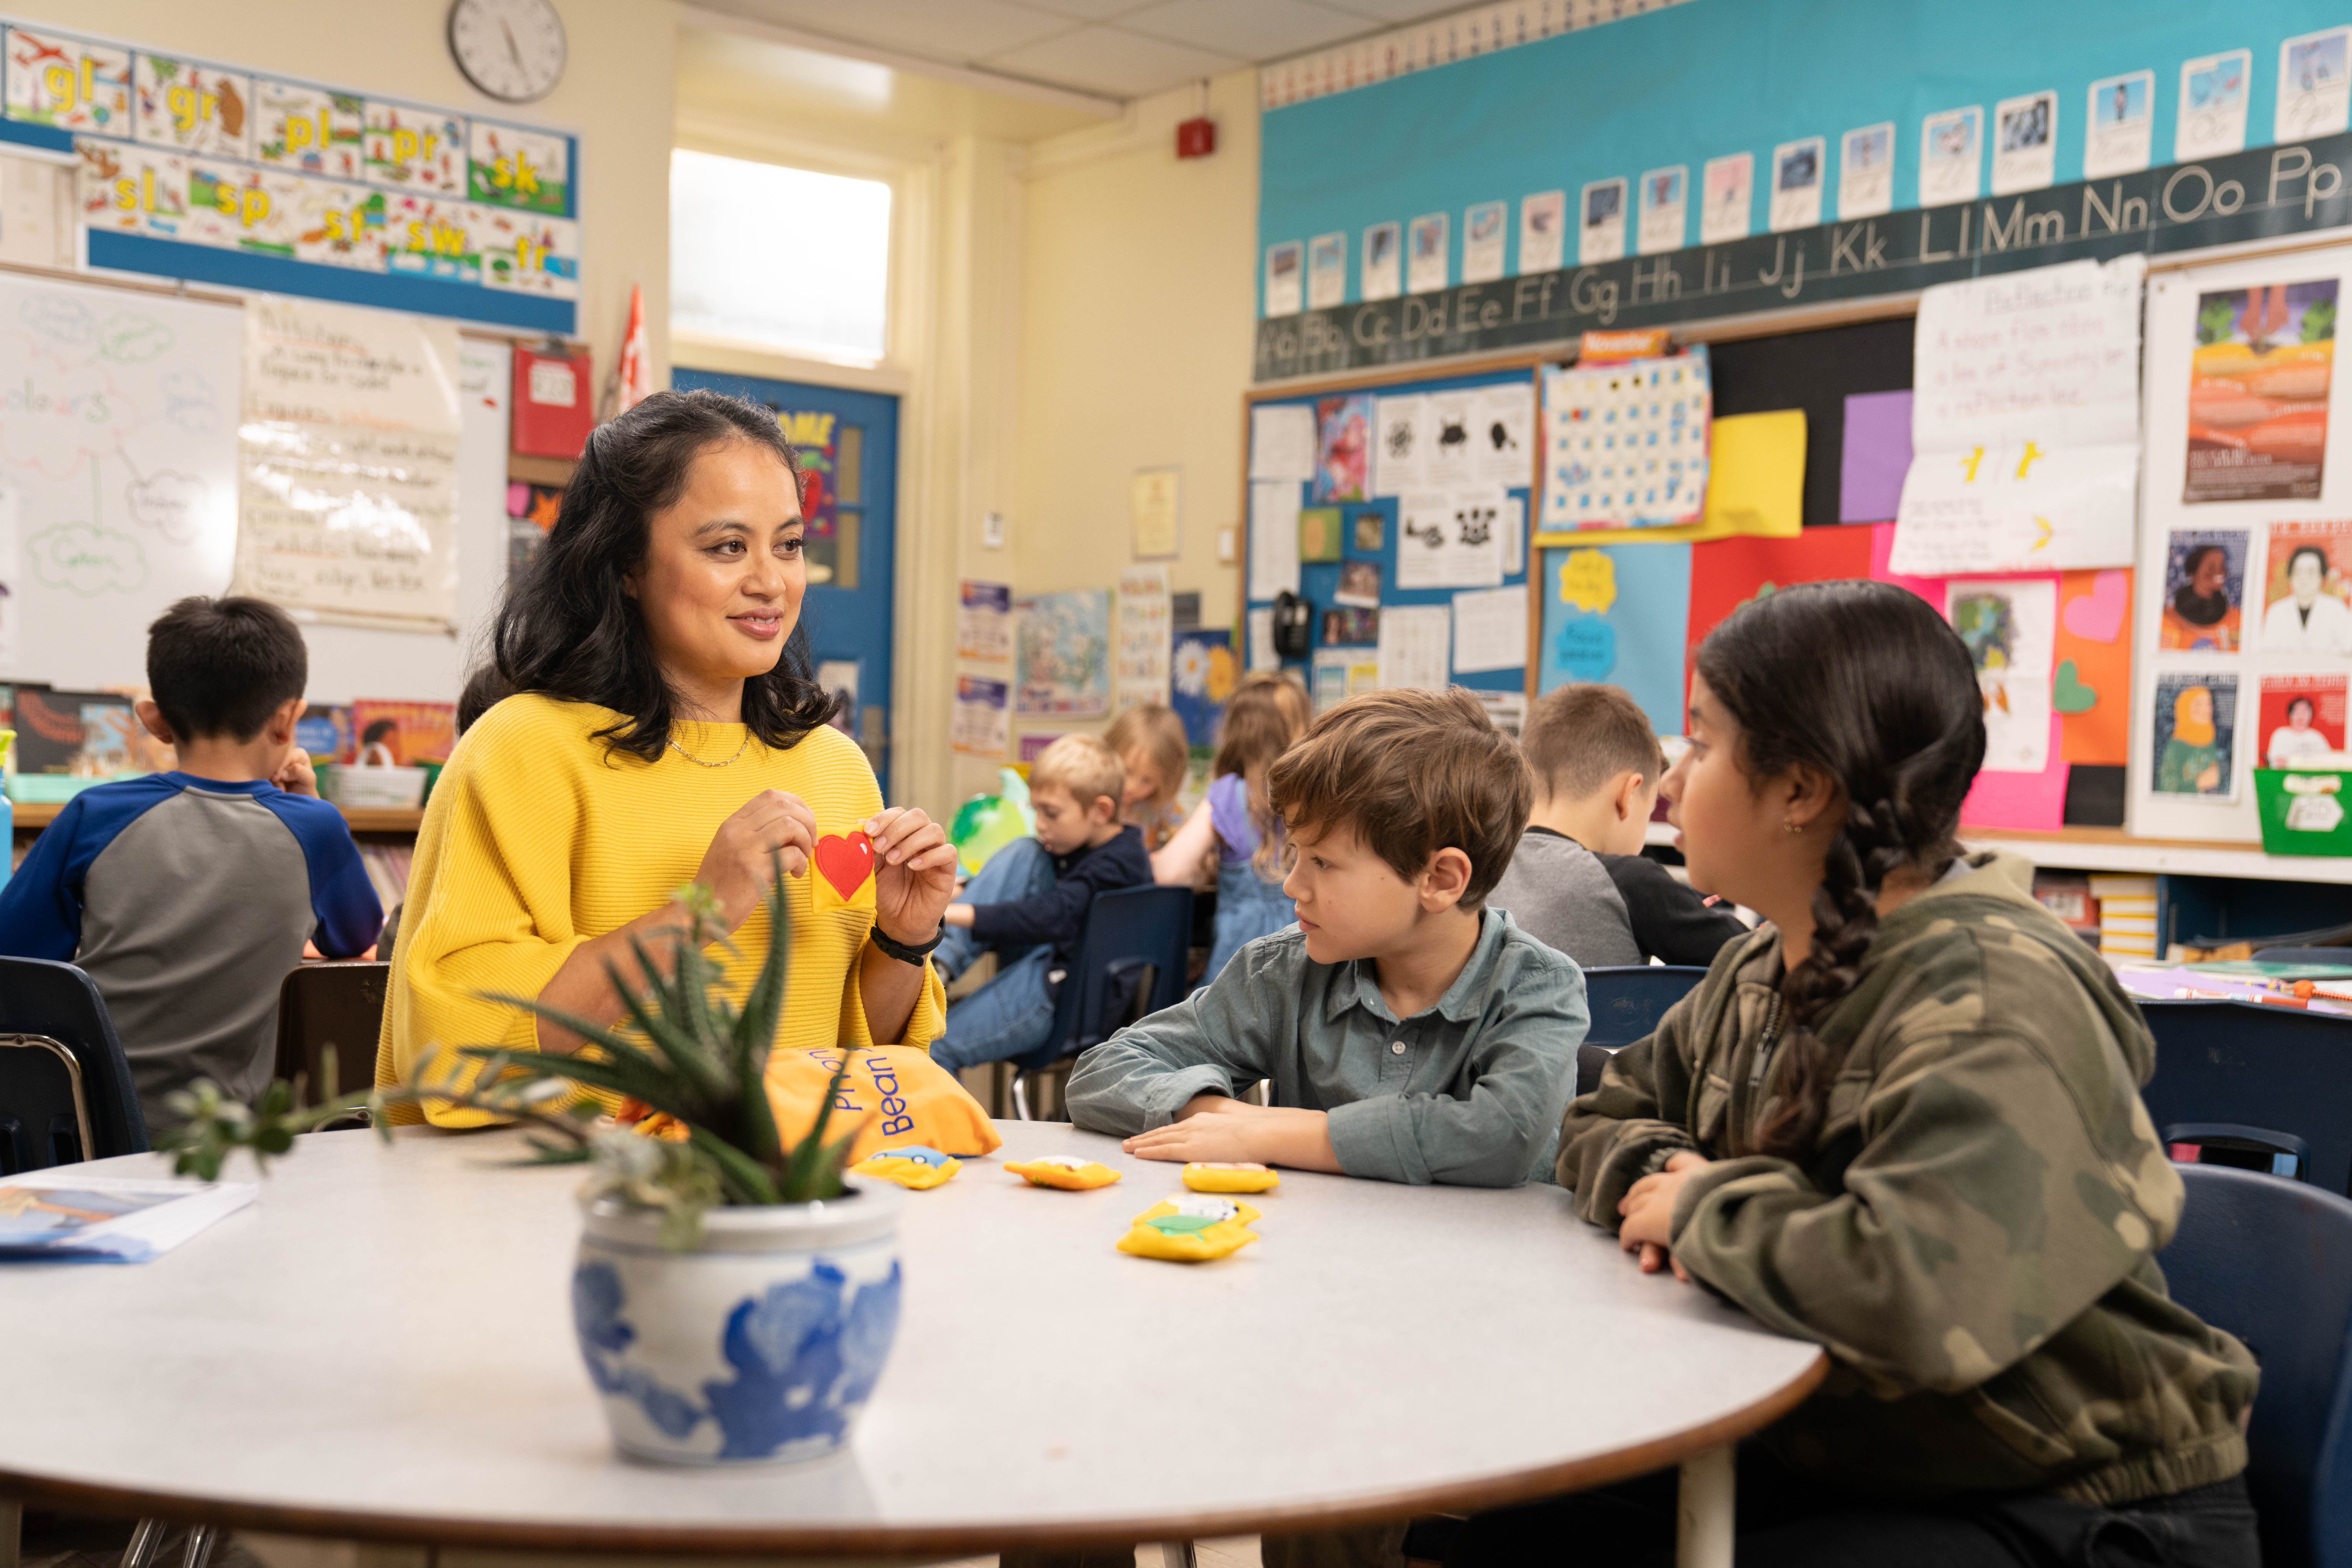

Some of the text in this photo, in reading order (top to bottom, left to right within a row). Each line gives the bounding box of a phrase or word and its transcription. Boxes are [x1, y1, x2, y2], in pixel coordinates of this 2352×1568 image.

[45, 55, 93, 112] gl
[167, 85, 218, 131] gr
[285, 108, 330, 153] pl
[394, 128, 439, 165] pr
[115, 169, 155, 213] sl
[492, 150, 540, 193] sk
[216, 182, 270, 227] sp
[407, 220, 465, 256] sw
[1353, 303, 1393, 347] Cc
[1401, 292, 1449, 341] Dd
[1457, 285, 1503, 334] Ee
[1512, 271, 1560, 324] Ff
[1570, 267, 1620, 326] Gg
[1631, 253, 1682, 306] Hh
[1759, 234, 1805, 299] Jj
[1830, 220, 1888, 276] Kk
[1982, 196, 2065, 255] Mm
[2080, 179, 2148, 240] Nn
[2162, 164, 2246, 223] Oo
[2267, 146, 2342, 221] Pp
[866, 1057, 915, 1136] Bean
